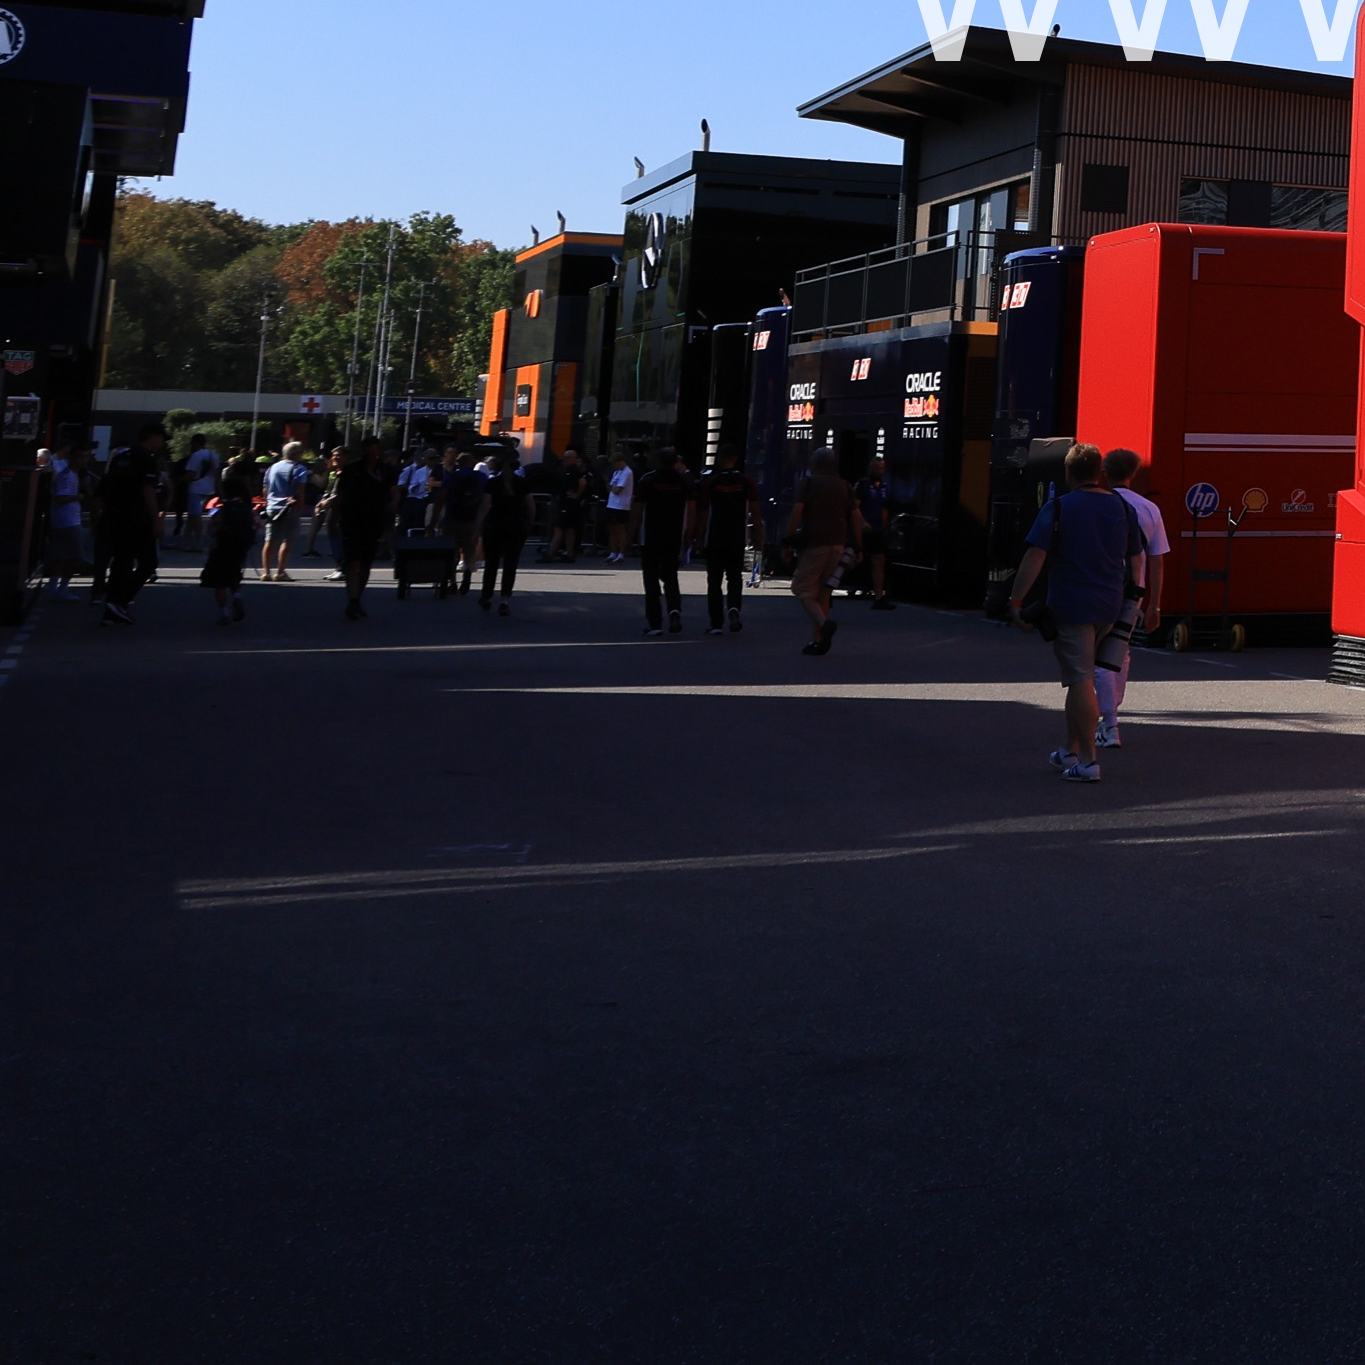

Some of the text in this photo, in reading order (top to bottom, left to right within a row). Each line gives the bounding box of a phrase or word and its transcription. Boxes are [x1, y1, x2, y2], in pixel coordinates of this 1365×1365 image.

[905, 371, 942, 393] ORACLE
[789, 382, 816, 401] ORACLE
[437, 402, 472, 411] CENTRE
[786, 429, 813, 440] RACING
[902, 426, 939, 439] RACING
